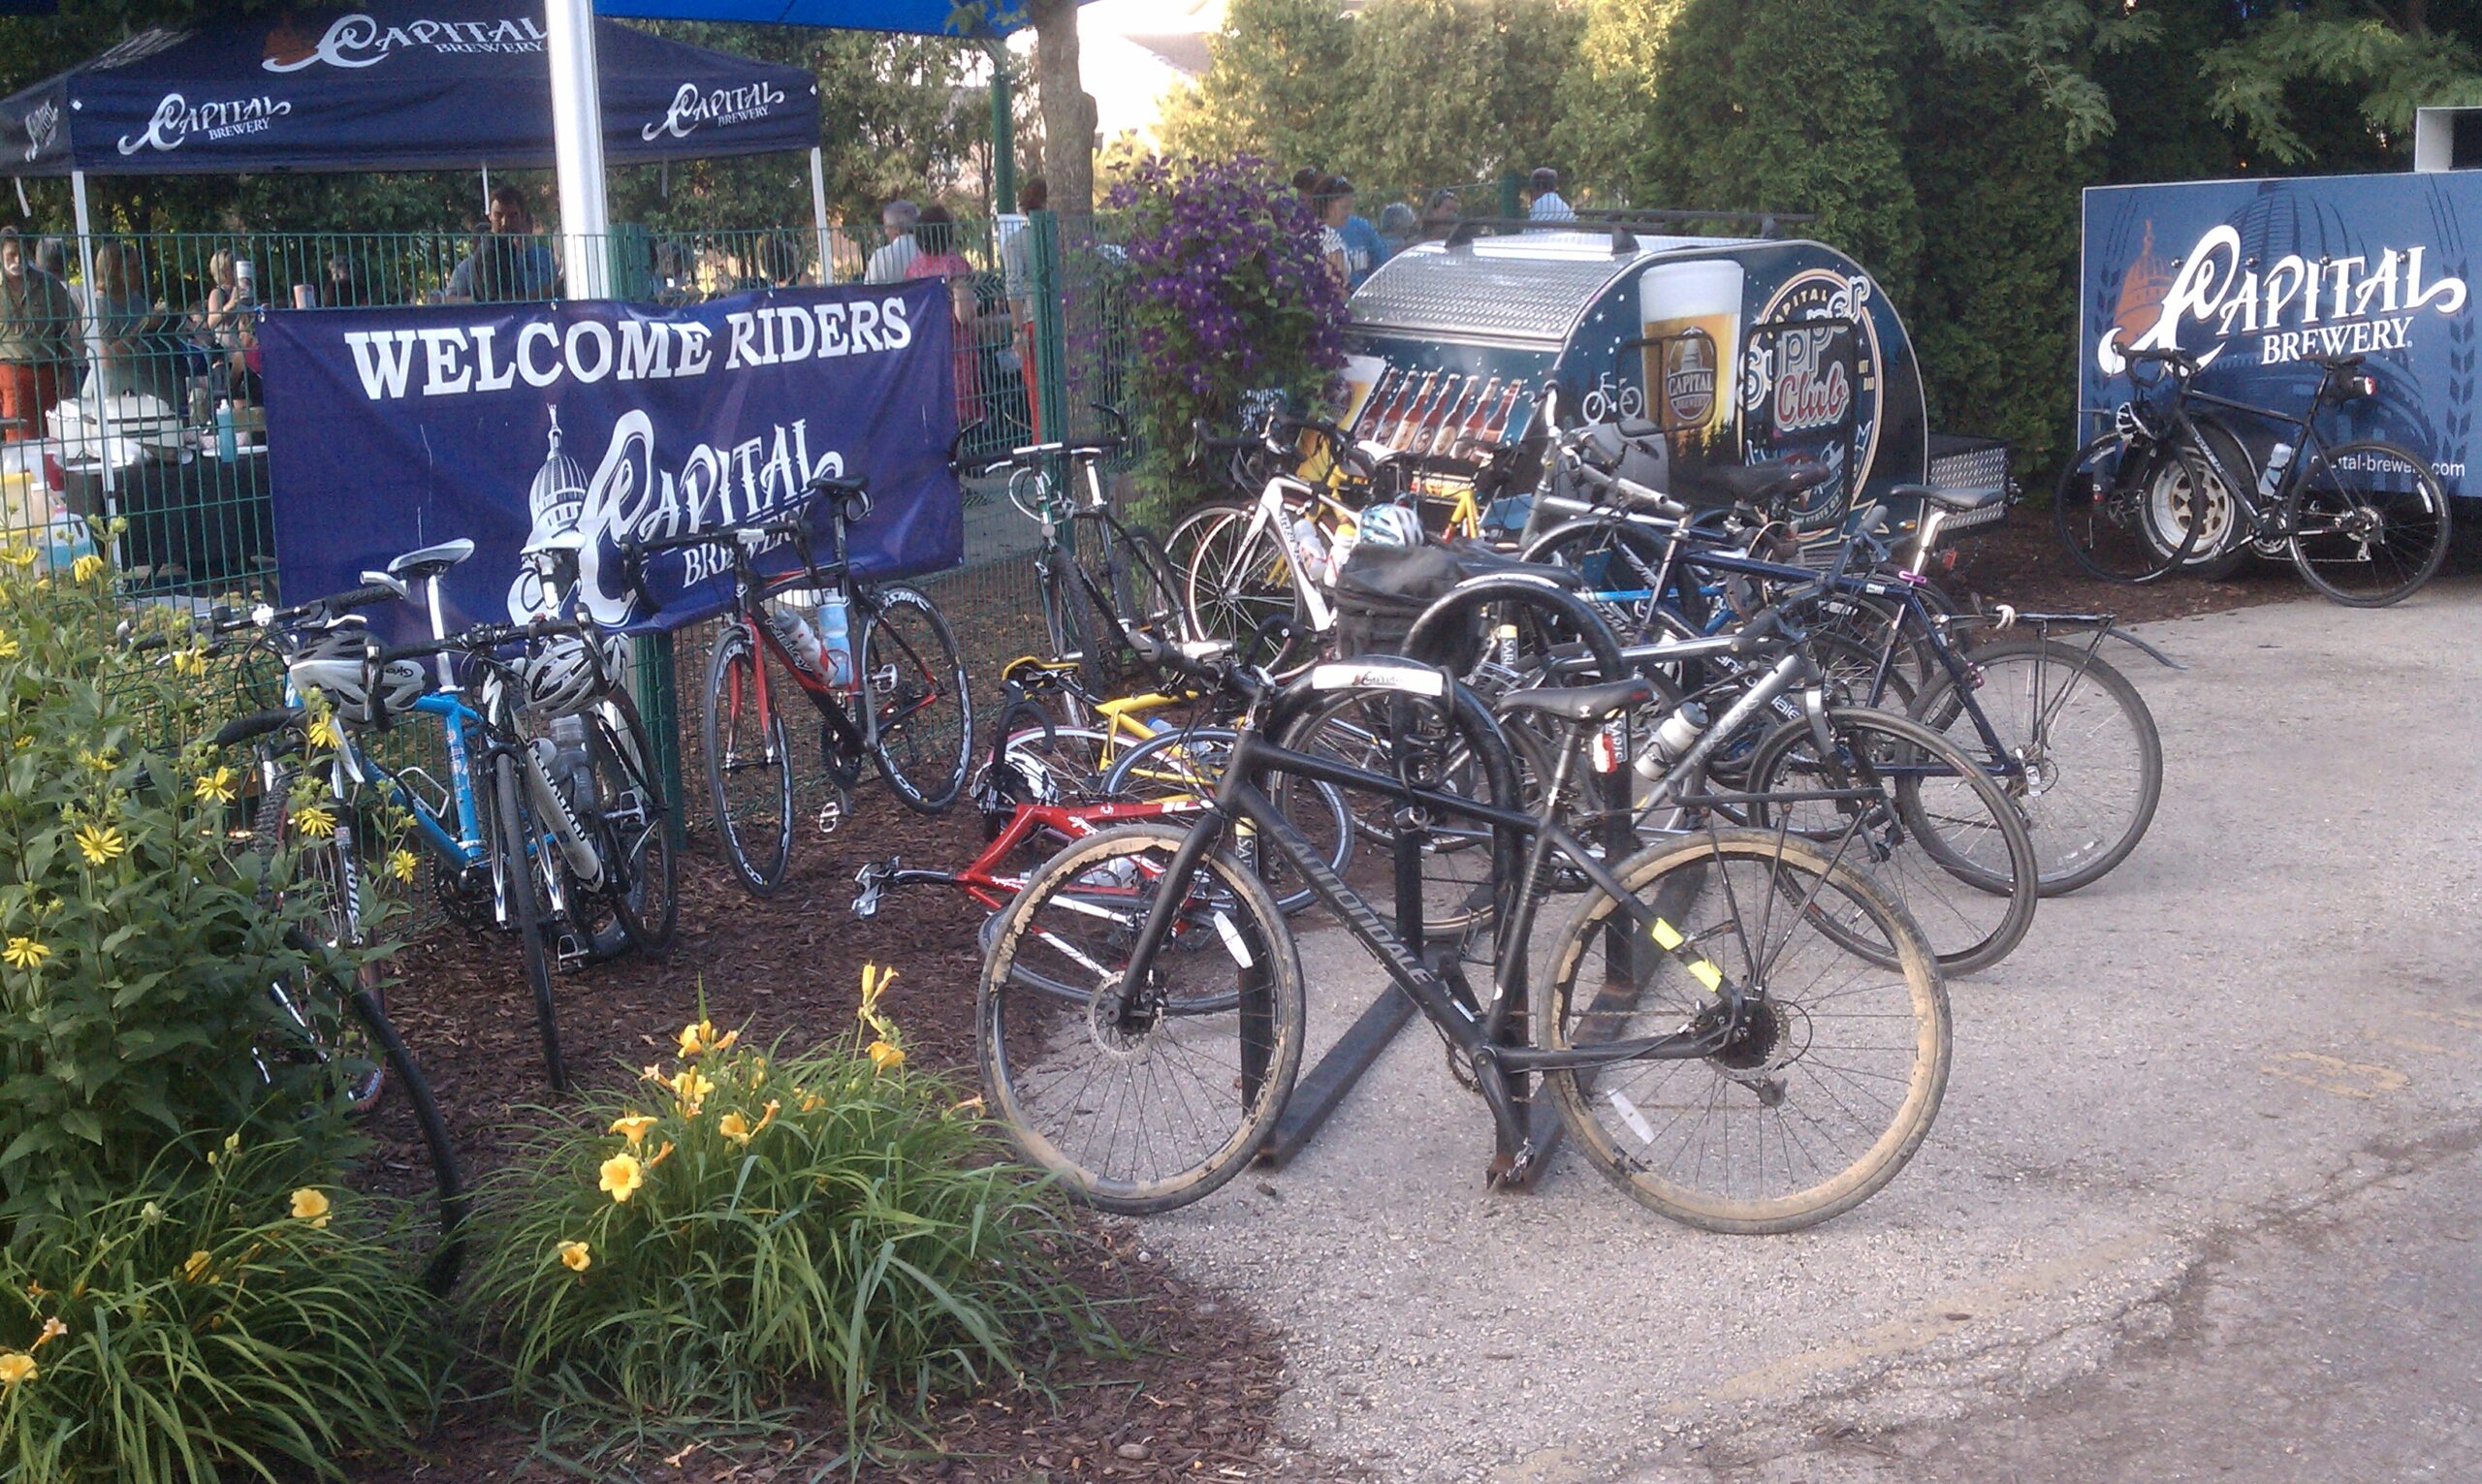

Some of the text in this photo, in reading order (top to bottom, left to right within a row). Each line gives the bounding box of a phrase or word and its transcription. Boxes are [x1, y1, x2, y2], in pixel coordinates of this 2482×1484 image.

[262, 14, 548, 73] CAPITAL
[435, 41, 544, 54] BREWERY
[117, 93, 292, 155] CAPITAL
[208, 117, 270, 142] BREWERY
[642, 81, 785, 142] CAPITAL
[717, 105, 770, 128] BREWERY
[2097, 224, 2467, 377] CAPITAL
[344, 297, 912, 401] WELCOME RIDERS
[2261, 316, 2413, 366] BREWERY
[1669, 372, 1713, 396] CAPITAL
[1774, 360, 1850, 432] Club
[507, 409, 843, 627] CAPITAL
